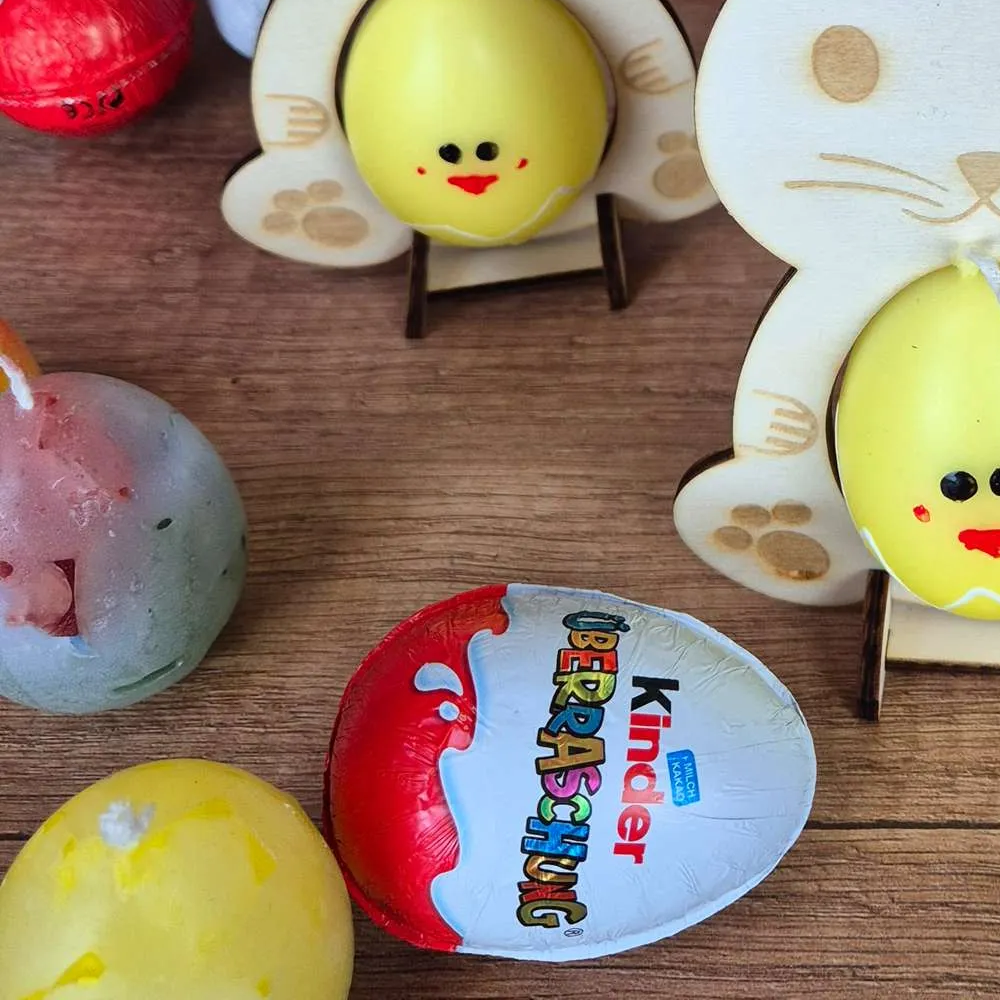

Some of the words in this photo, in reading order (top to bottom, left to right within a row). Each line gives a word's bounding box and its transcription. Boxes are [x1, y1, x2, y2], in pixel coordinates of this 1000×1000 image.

[516, 610, 631, 929] ÜBERRASCHUNG
[612, 676, 680, 865] Kinder
[671, 761, 685, 801] KAKAO
[684, 762, 696, 798] MILCH
